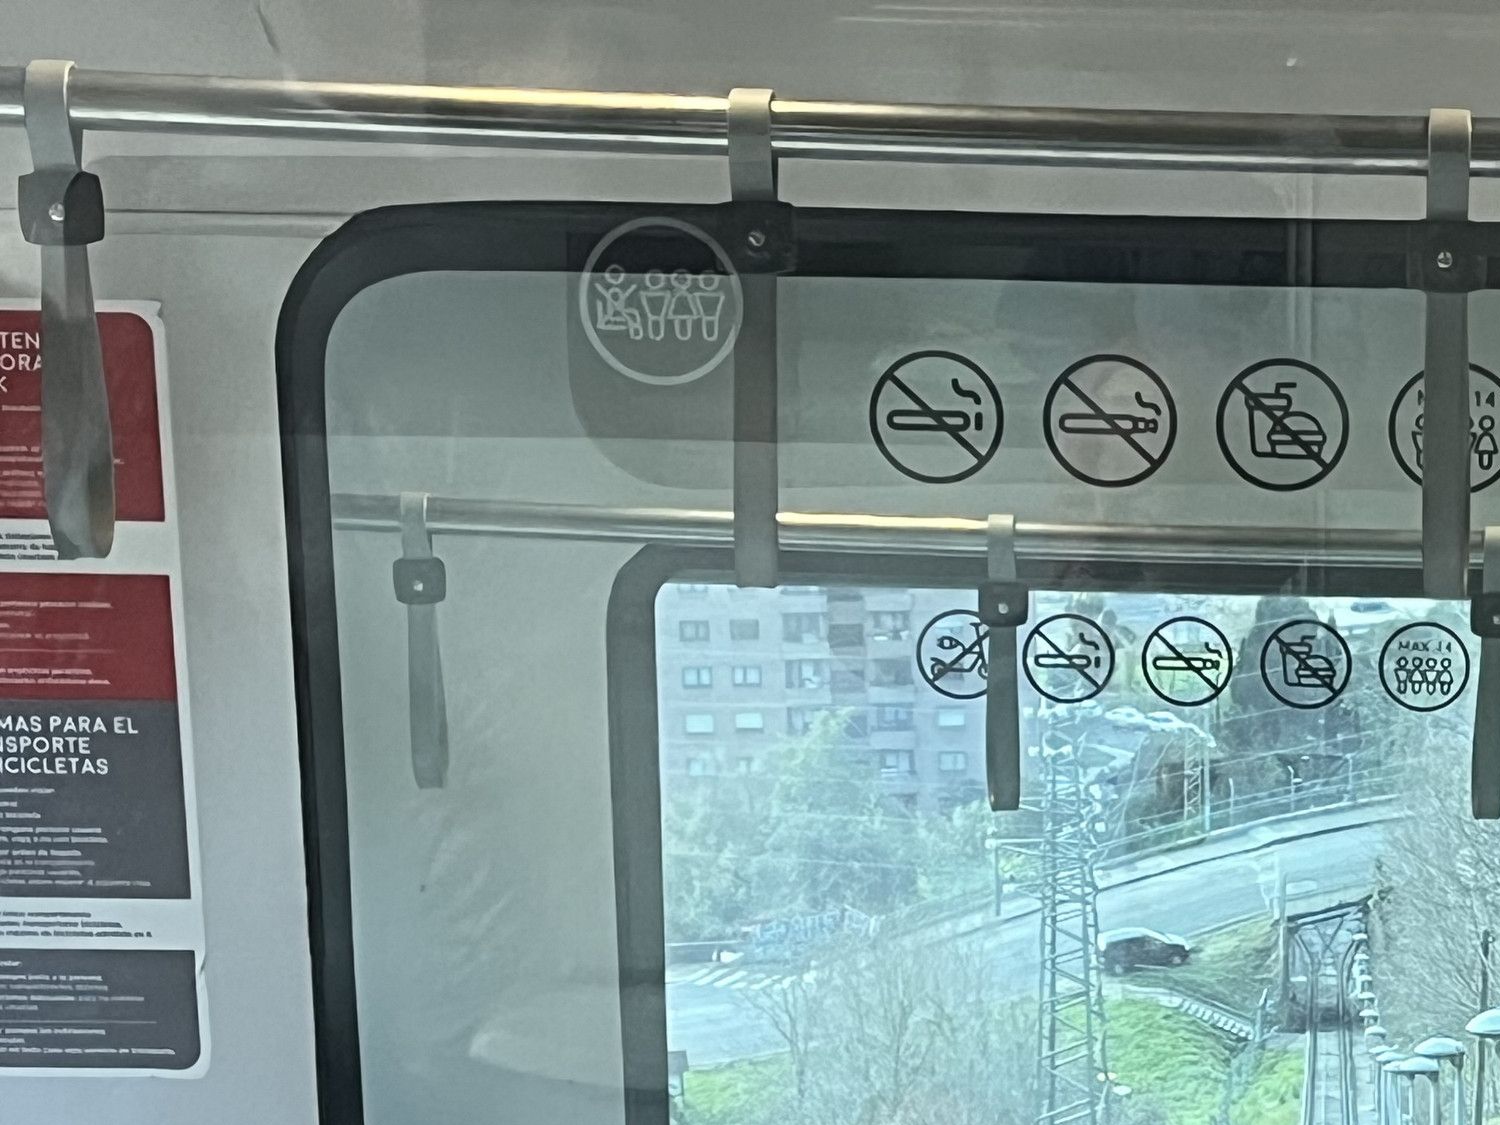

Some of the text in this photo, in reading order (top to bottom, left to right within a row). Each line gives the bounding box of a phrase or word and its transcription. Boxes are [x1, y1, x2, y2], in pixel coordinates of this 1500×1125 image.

[1398, 640, 1430, 652] MAX
[49, 716, 107, 733] PARA
[113, 716, 139, 734] EL
[0, 736, 91, 754] SPORTE
